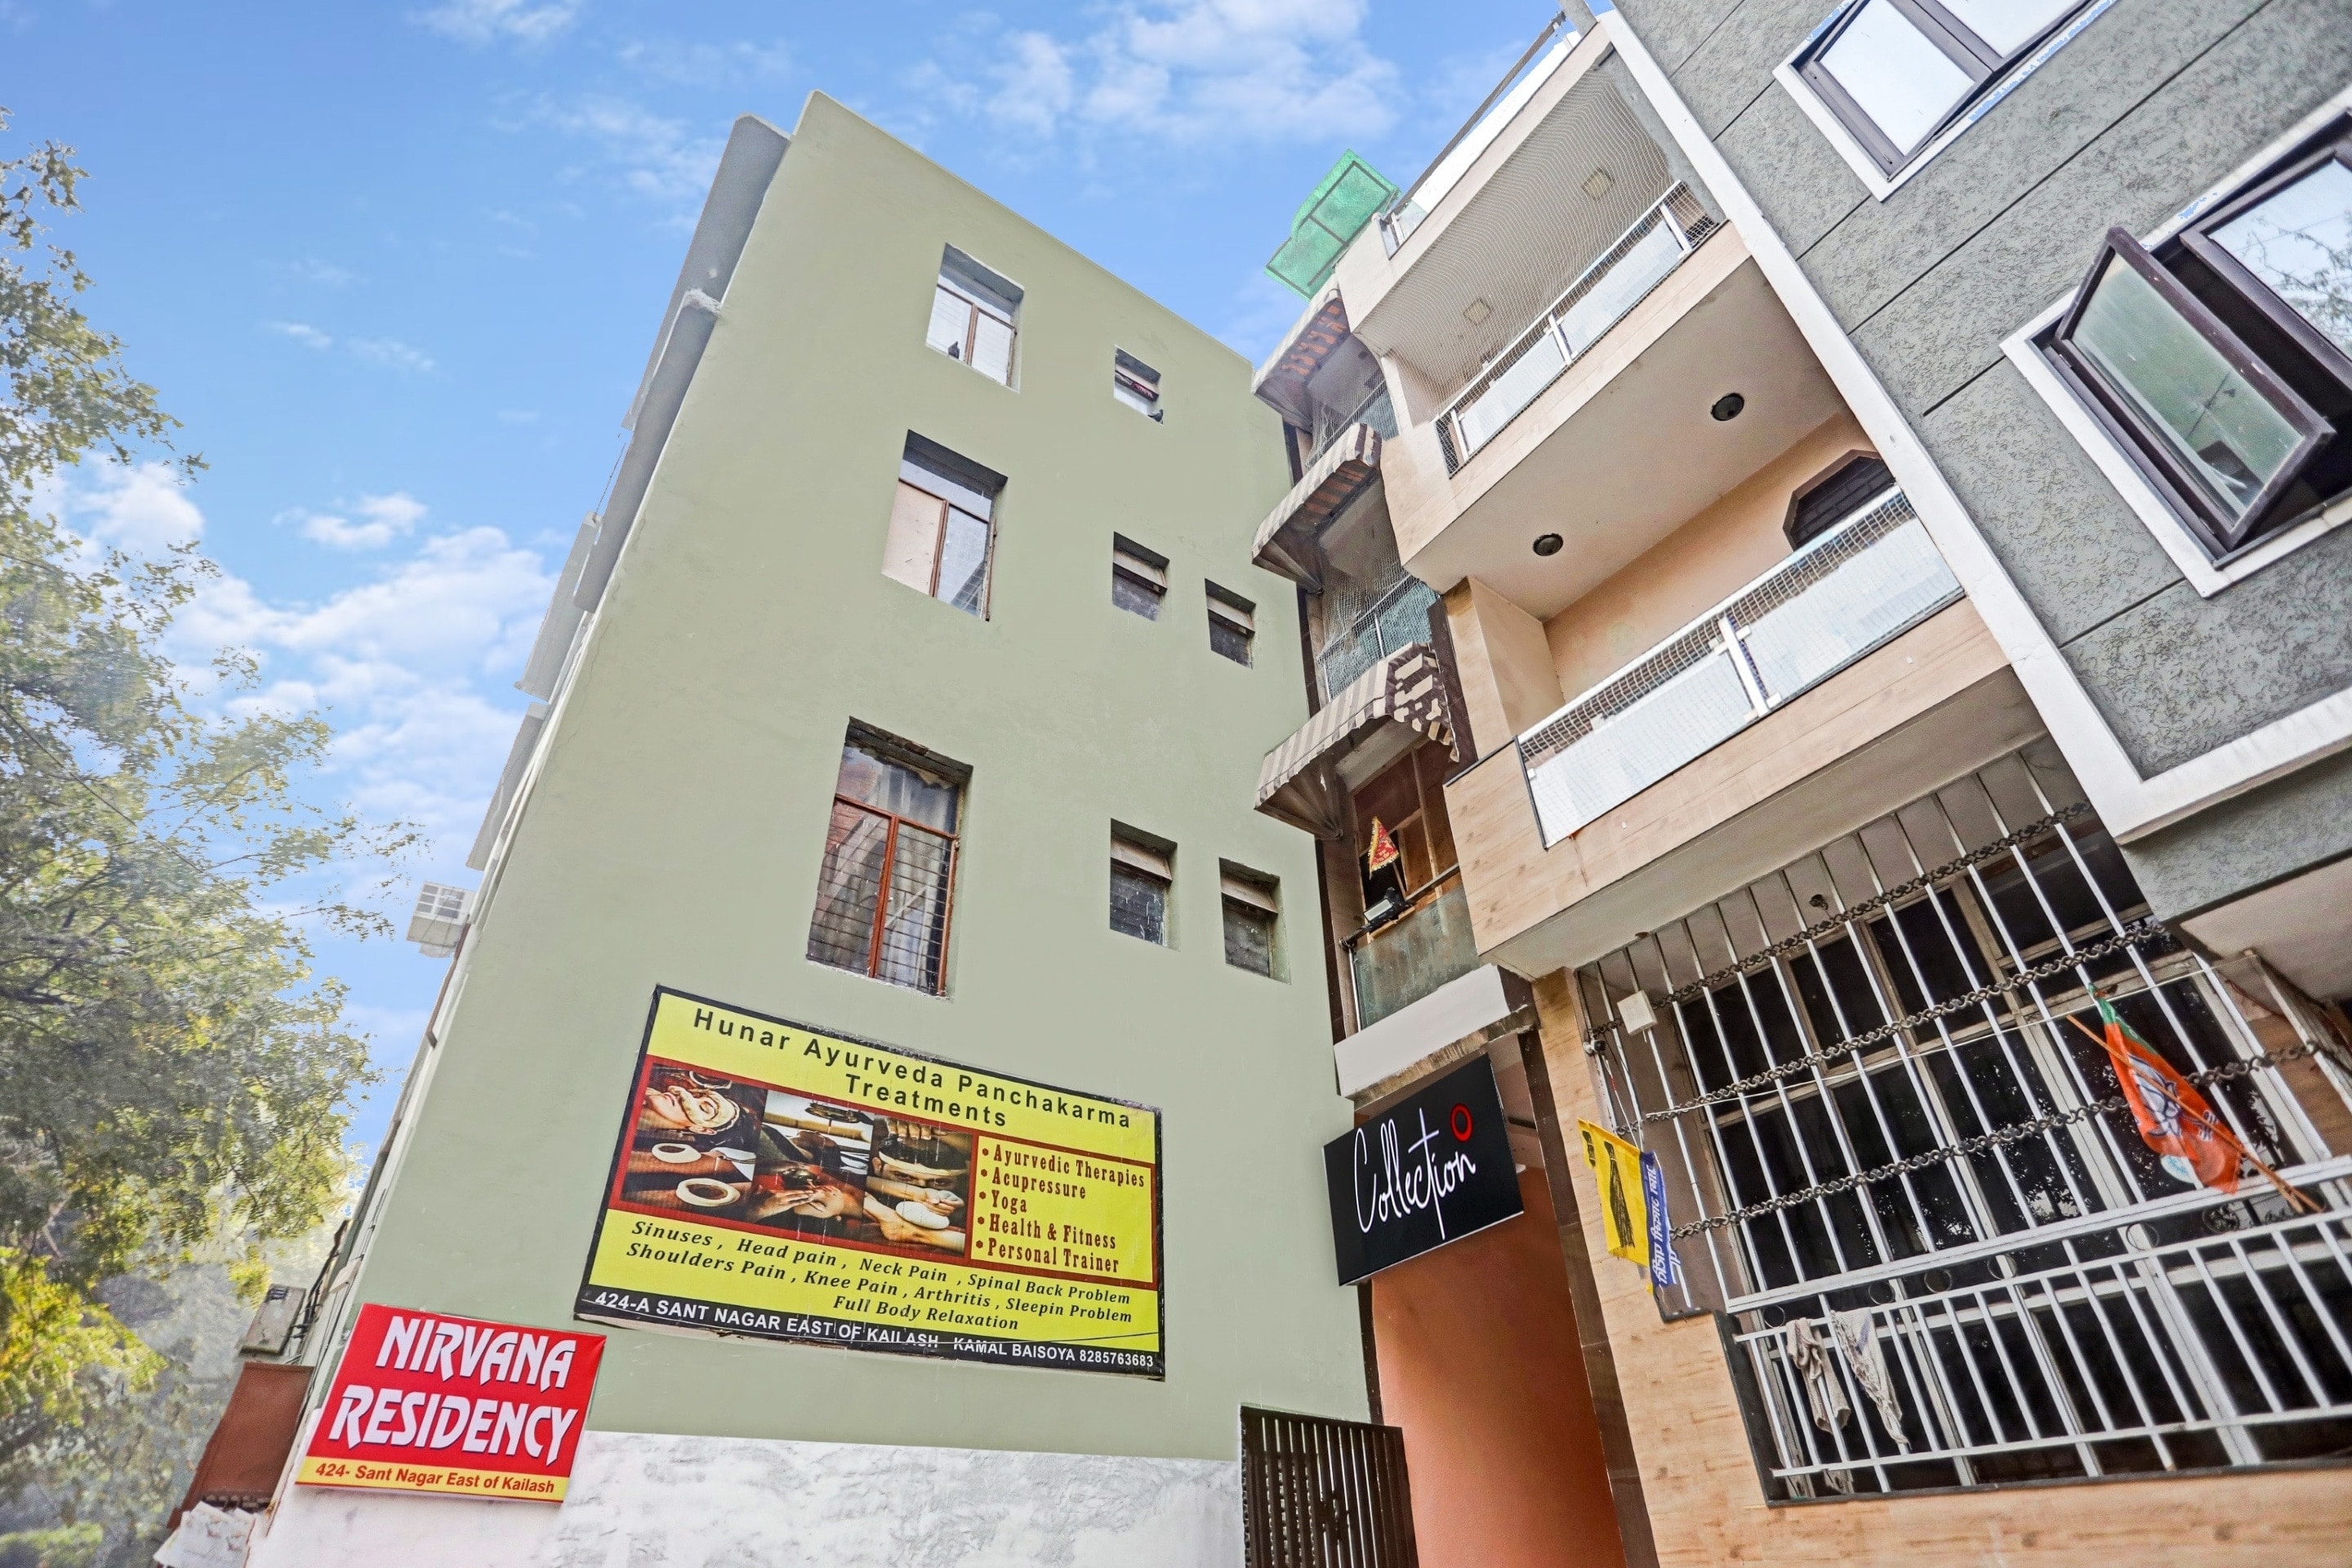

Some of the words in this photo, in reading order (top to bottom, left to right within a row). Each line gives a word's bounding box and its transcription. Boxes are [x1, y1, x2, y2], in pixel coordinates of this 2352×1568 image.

[693, 1008, 790, 1050] Hunar
[803, 1038, 943, 1088] Ayurveda
[958, 1074, 1129, 1128] Panchakarma
[845, 1073, 1006, 1127] Treatments
[992, 1166, 1086, 1199] Acupressure
[993, 1144, 1070, 1174] Ayurvedic
[1076, 1160, 1144, 1187] Therapies
[1353, 1102, 1477, 1241] Collection
[991, 1189, 1027, 1215] Yoga
[987, 1237, 1057, 1265] Personal
[1062, 1248, 1119, 1272] Trainer
[989, 1213, 1041, 1239] Health
[1047, 1223, 1057, 1241] &
[1062, 1224, 1116, 1250] Fitness
[626, 1242, 735, 1272] Shoulders
[803, 1270, 852, 1289] Knee
[1005, 1298, 1064, 1316] Sleepin
[1069, 1305, 1133, 1322] Problem
[737, 1237, 789, 1258] Head
[859, 1258, 903, 1276] Neck
[967, 1273, 1021, 1292] Spinal
[1025, 1281, 1063, 1297] Back
[1067, 1286, 1131, 1305] Problem
[595, 1291, 650, 1313] 424-A
[656, 1299, 710, 1321] SANT
[714, 1307, 782, 1330] NAGAR
[786, 1316, 834, 1336] EAST
[838, 1323, 862, 1339] OF
[866, 1327, 938, 1348] KAILASH
[953, 1337, 1008, 1356] KAMAL
[1012, 1343, 1076, 1361] BAISOYA
[1079, 1349, 1154, 1368] 8285763683
[832, 1295, 871, 1313] Full
[875, 1301, 921, 1321] Body
[926, 1307, 1019, 1330] Relaxation
[376, 1316, 577, 1393] NIRVANA
[327, 1383, 579, 1467] RESIDENCY
[315, 1463, 350, 1478] 424-
[354, 1464, 392, 1481] Sant
[394, 1468, 443, 1486] Nagar
[446, 1472, 480, 1489] East
[483, 1473, 498, 1489] of
[501, 1477, 555, 1494] Kailash
